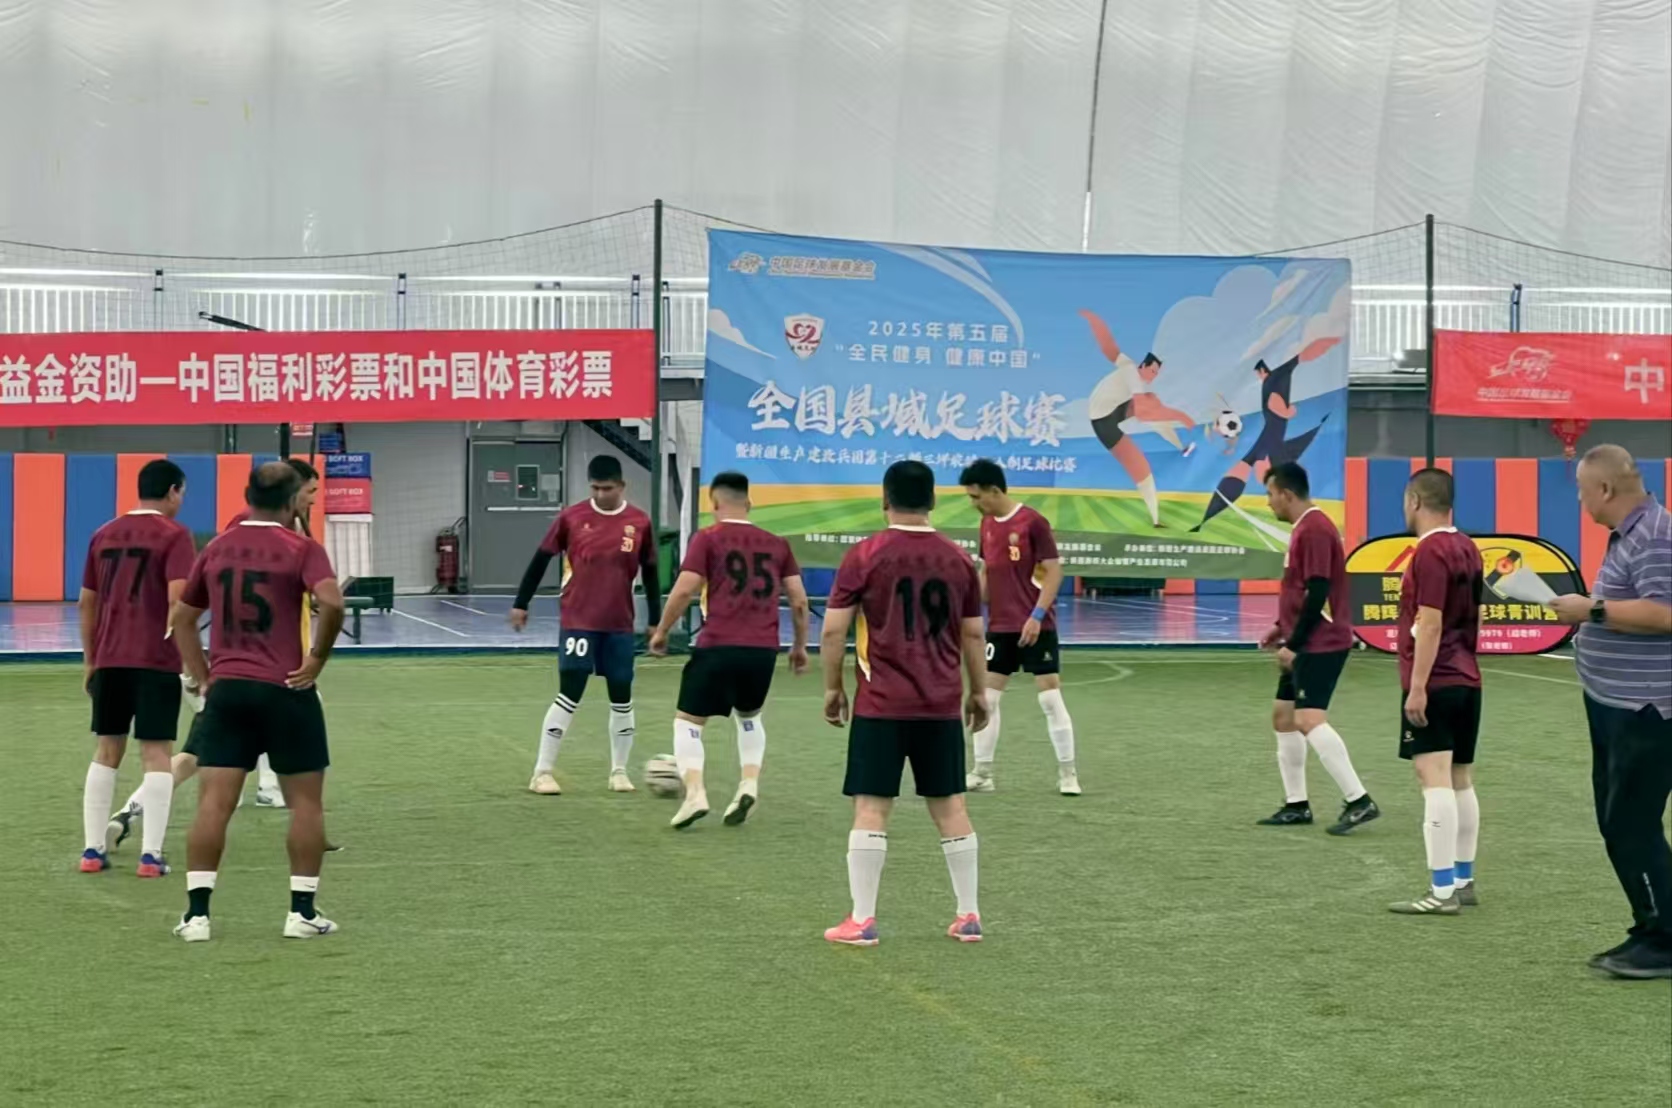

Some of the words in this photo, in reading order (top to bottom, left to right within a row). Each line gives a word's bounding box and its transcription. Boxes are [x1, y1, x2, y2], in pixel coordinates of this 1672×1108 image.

[868, 320, 1009, 343] 2025年第五届
[1624, 358, 1665, 405] 中
[748, 380, 1067, 447] 全国县域足球赛
[100, 547, 149, 600] 77
[725, 549, 774, 599] 95
[218, 567, 273, 634] 15
[896, 576, 950, 640] 19
[565, 637, 588, 657] 90
